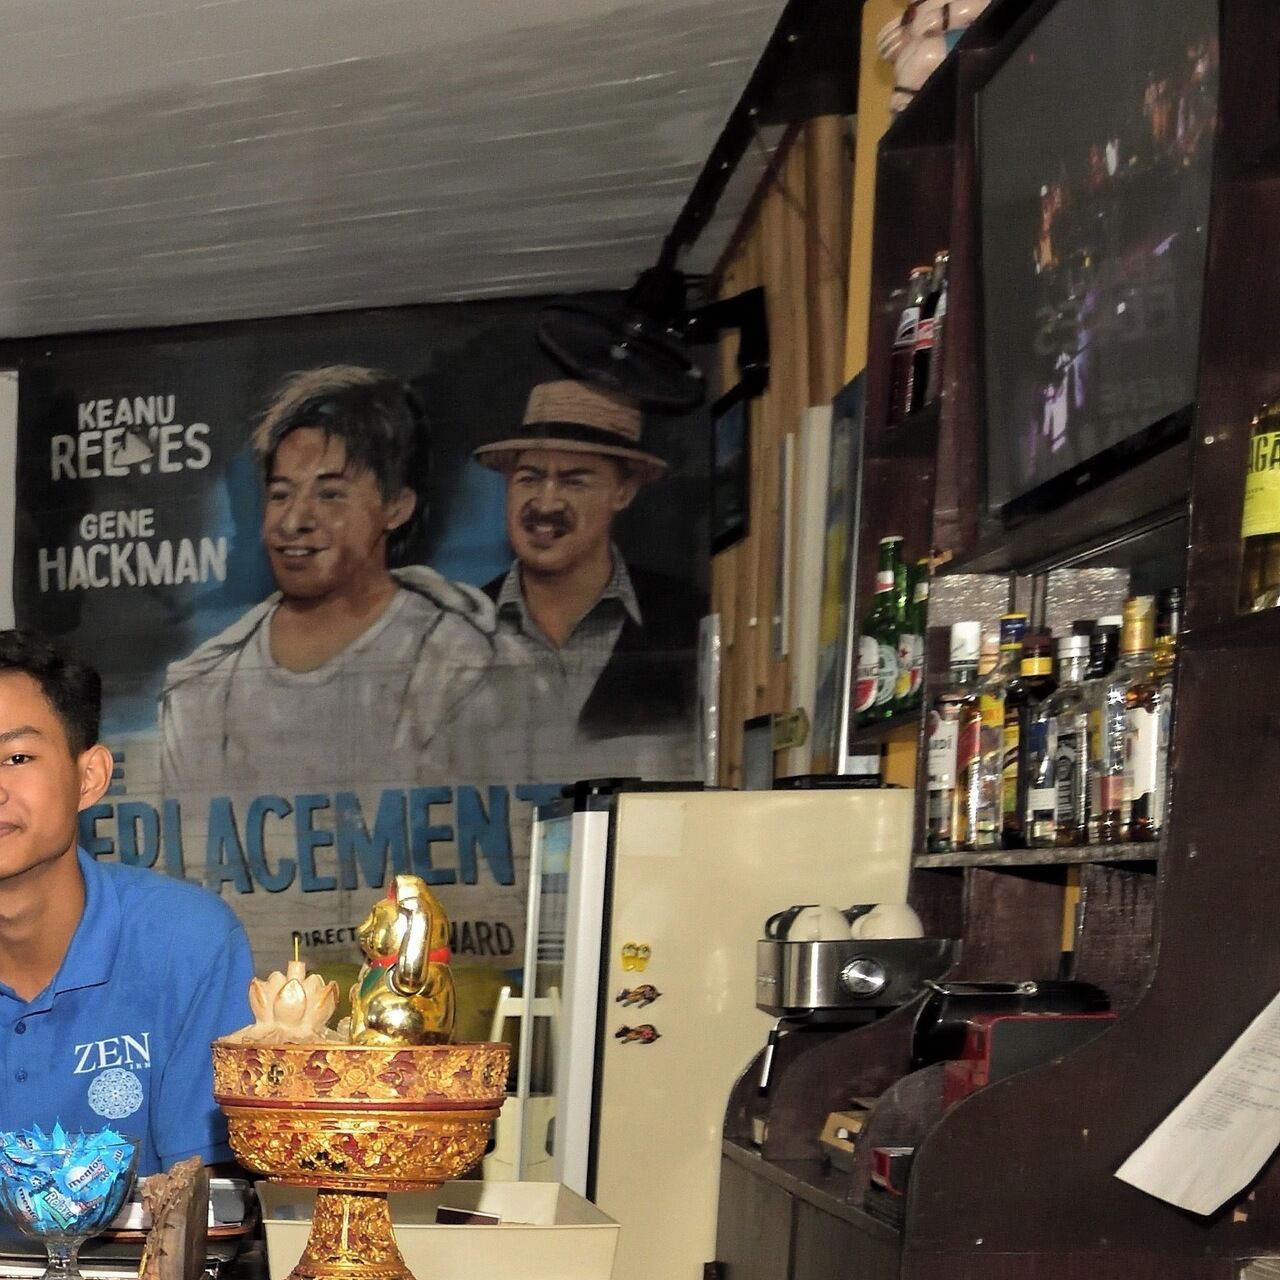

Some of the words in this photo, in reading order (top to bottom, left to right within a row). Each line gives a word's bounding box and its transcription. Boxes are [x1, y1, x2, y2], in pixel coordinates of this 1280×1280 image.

[77, 395, 176, 430] KEANU
[79, 508, 155, 540] GENE
[38, 537, 228, 592] HACKMAN
[292, 926, 358, 947] DIRECT
[73, 1032, 151, 1074] ZEN
[68, 1157, 103, 1188] mentos
[19, 1188, 39, 1219] mento
